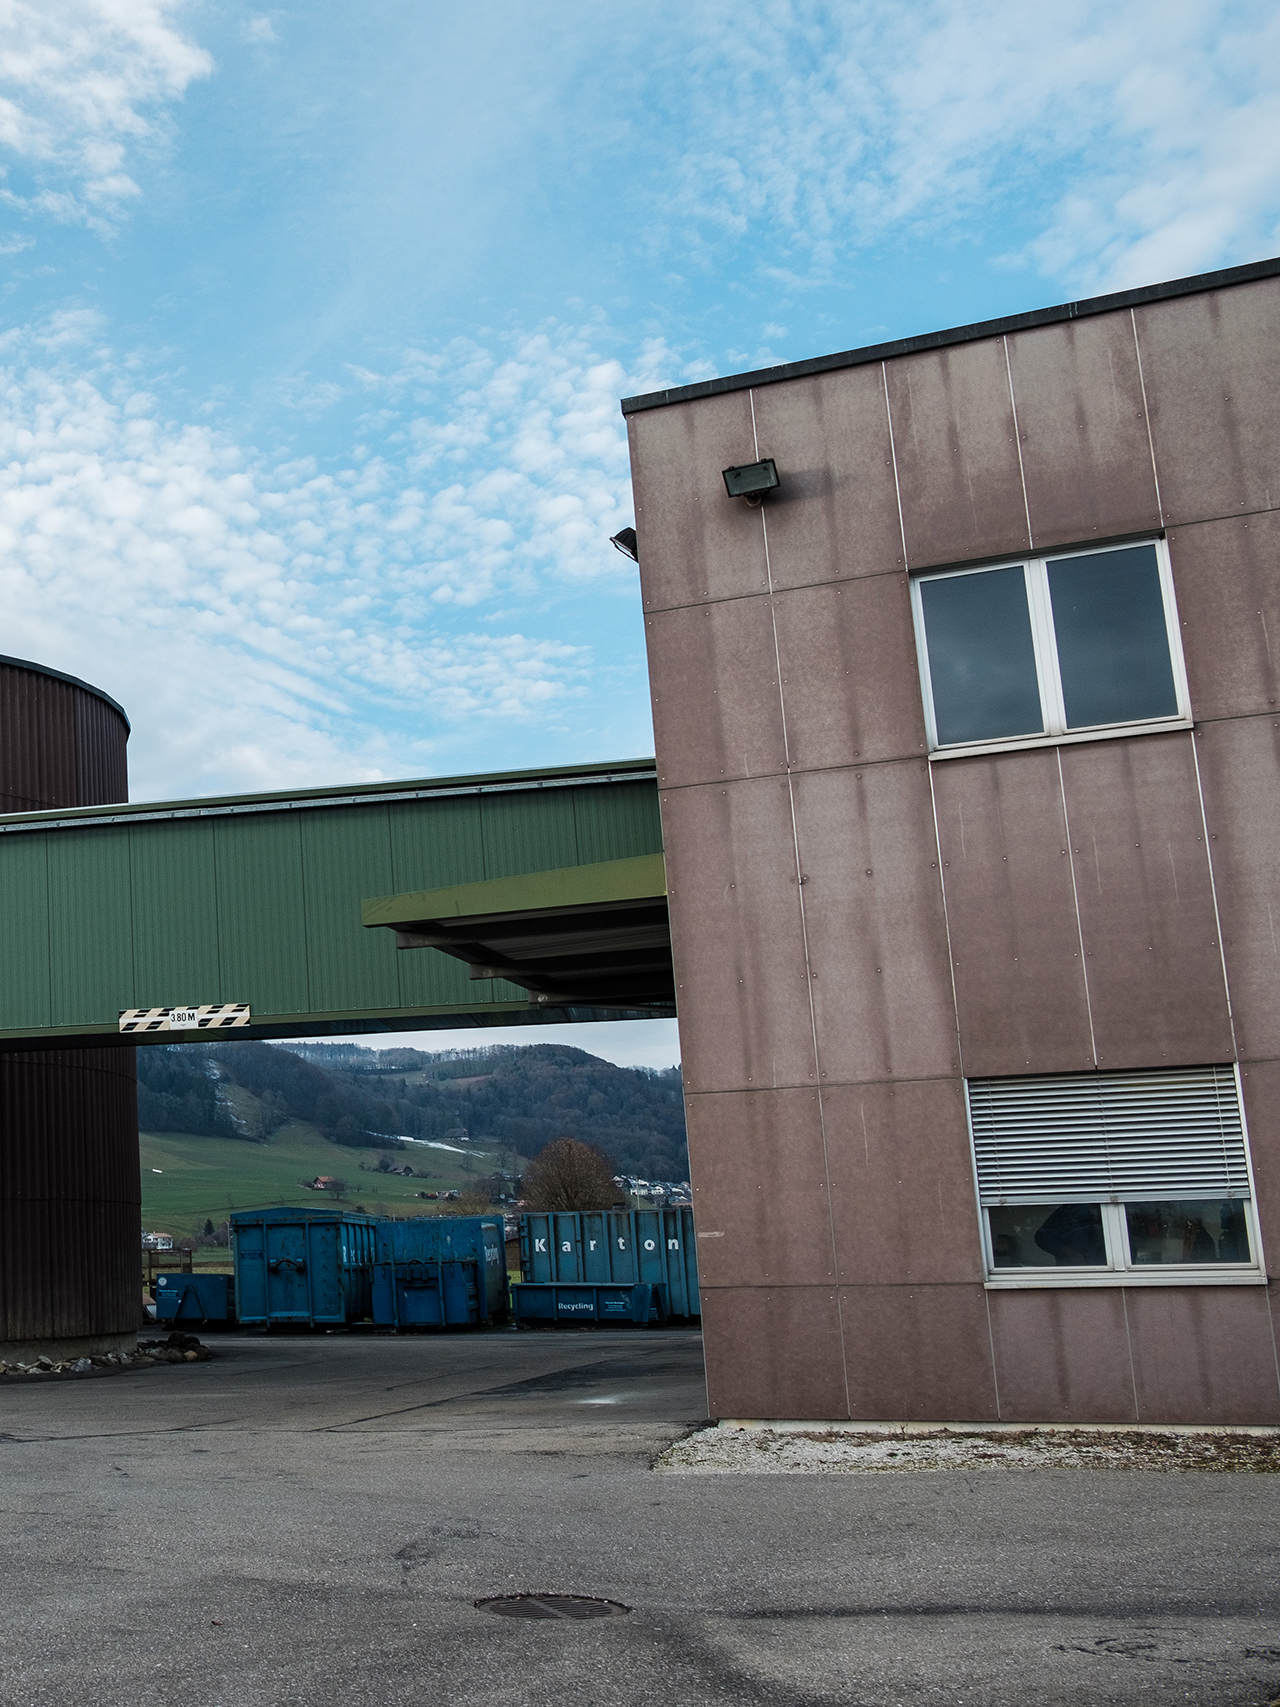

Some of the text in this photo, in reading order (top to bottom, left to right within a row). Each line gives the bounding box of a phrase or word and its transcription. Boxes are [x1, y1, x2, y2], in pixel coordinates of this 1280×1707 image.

[187, 1012, 196, 1021] M
[534, 1236, 680, 1252] Karton
[558, 1302, 594, 1311] Recycling
